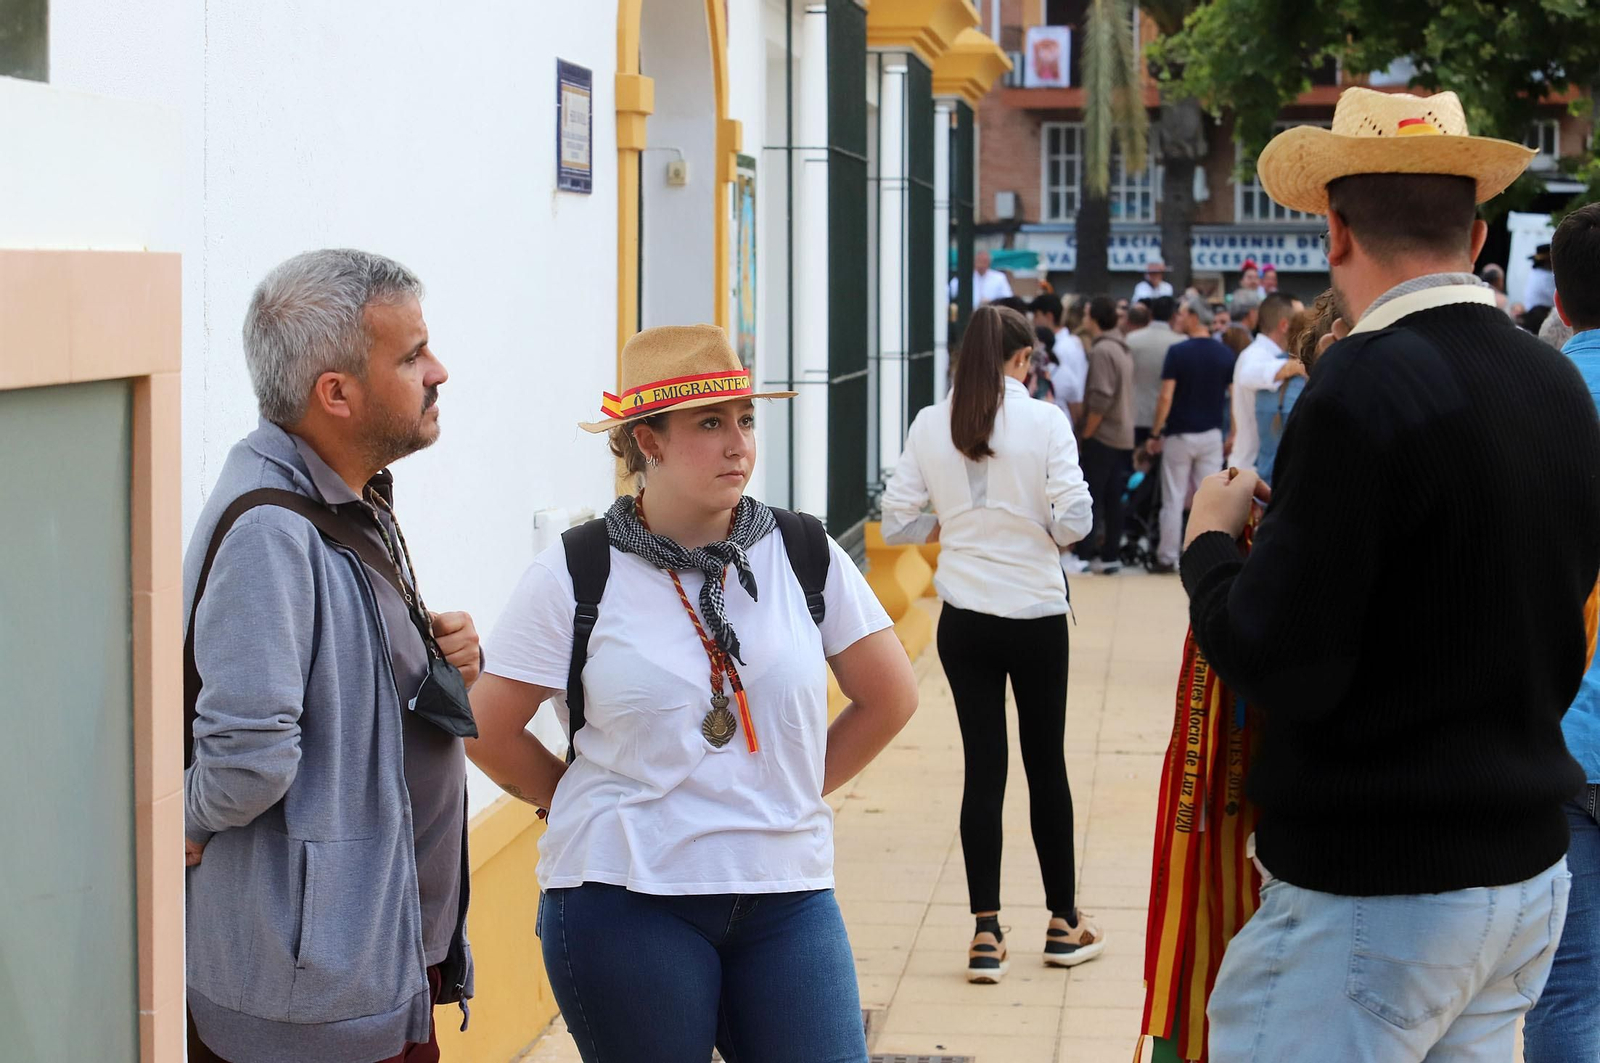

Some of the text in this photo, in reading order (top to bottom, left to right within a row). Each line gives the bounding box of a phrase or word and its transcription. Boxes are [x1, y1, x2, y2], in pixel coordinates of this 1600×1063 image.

[1197, 251, 1309, 266] CCESORIOS
[1185, 750, 1203, 767] de
[1182, 772, 1201, 798] Luz
[1175, 801, 1197, 834] 2020
